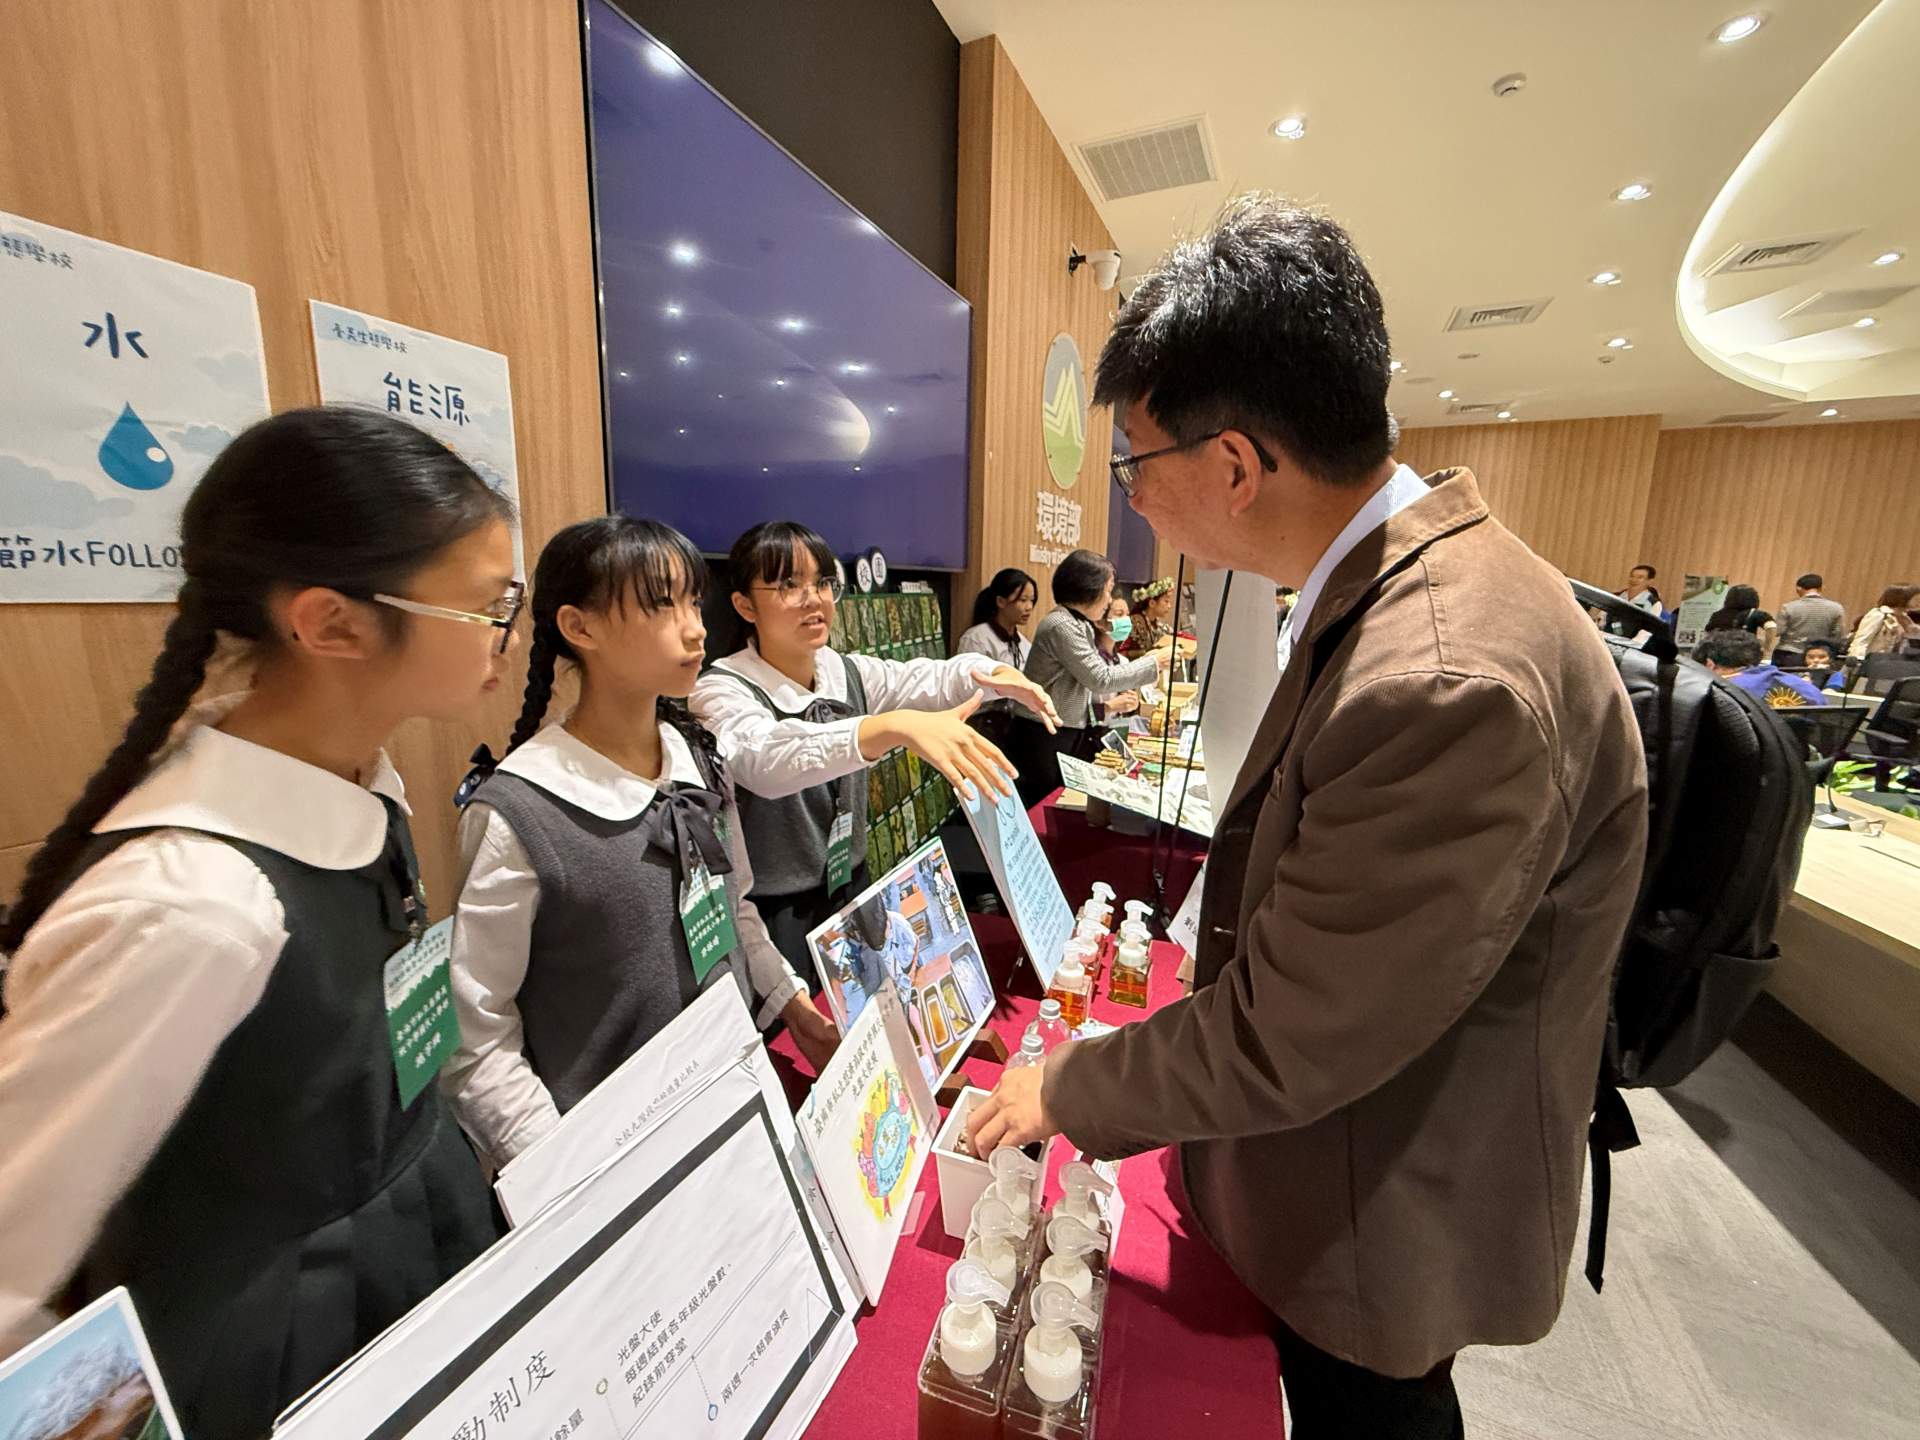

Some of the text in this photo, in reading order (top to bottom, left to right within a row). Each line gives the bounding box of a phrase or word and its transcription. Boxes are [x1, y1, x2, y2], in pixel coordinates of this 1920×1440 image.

[82, 311, 150, 358] 水
[383, 371, 470, 426] 能源
[0, 534, 183, 570] 節水FOLLO
[617, 1310, 662, 1367] 光盤大使
[549, 1408, 584, 1440] 餘量
